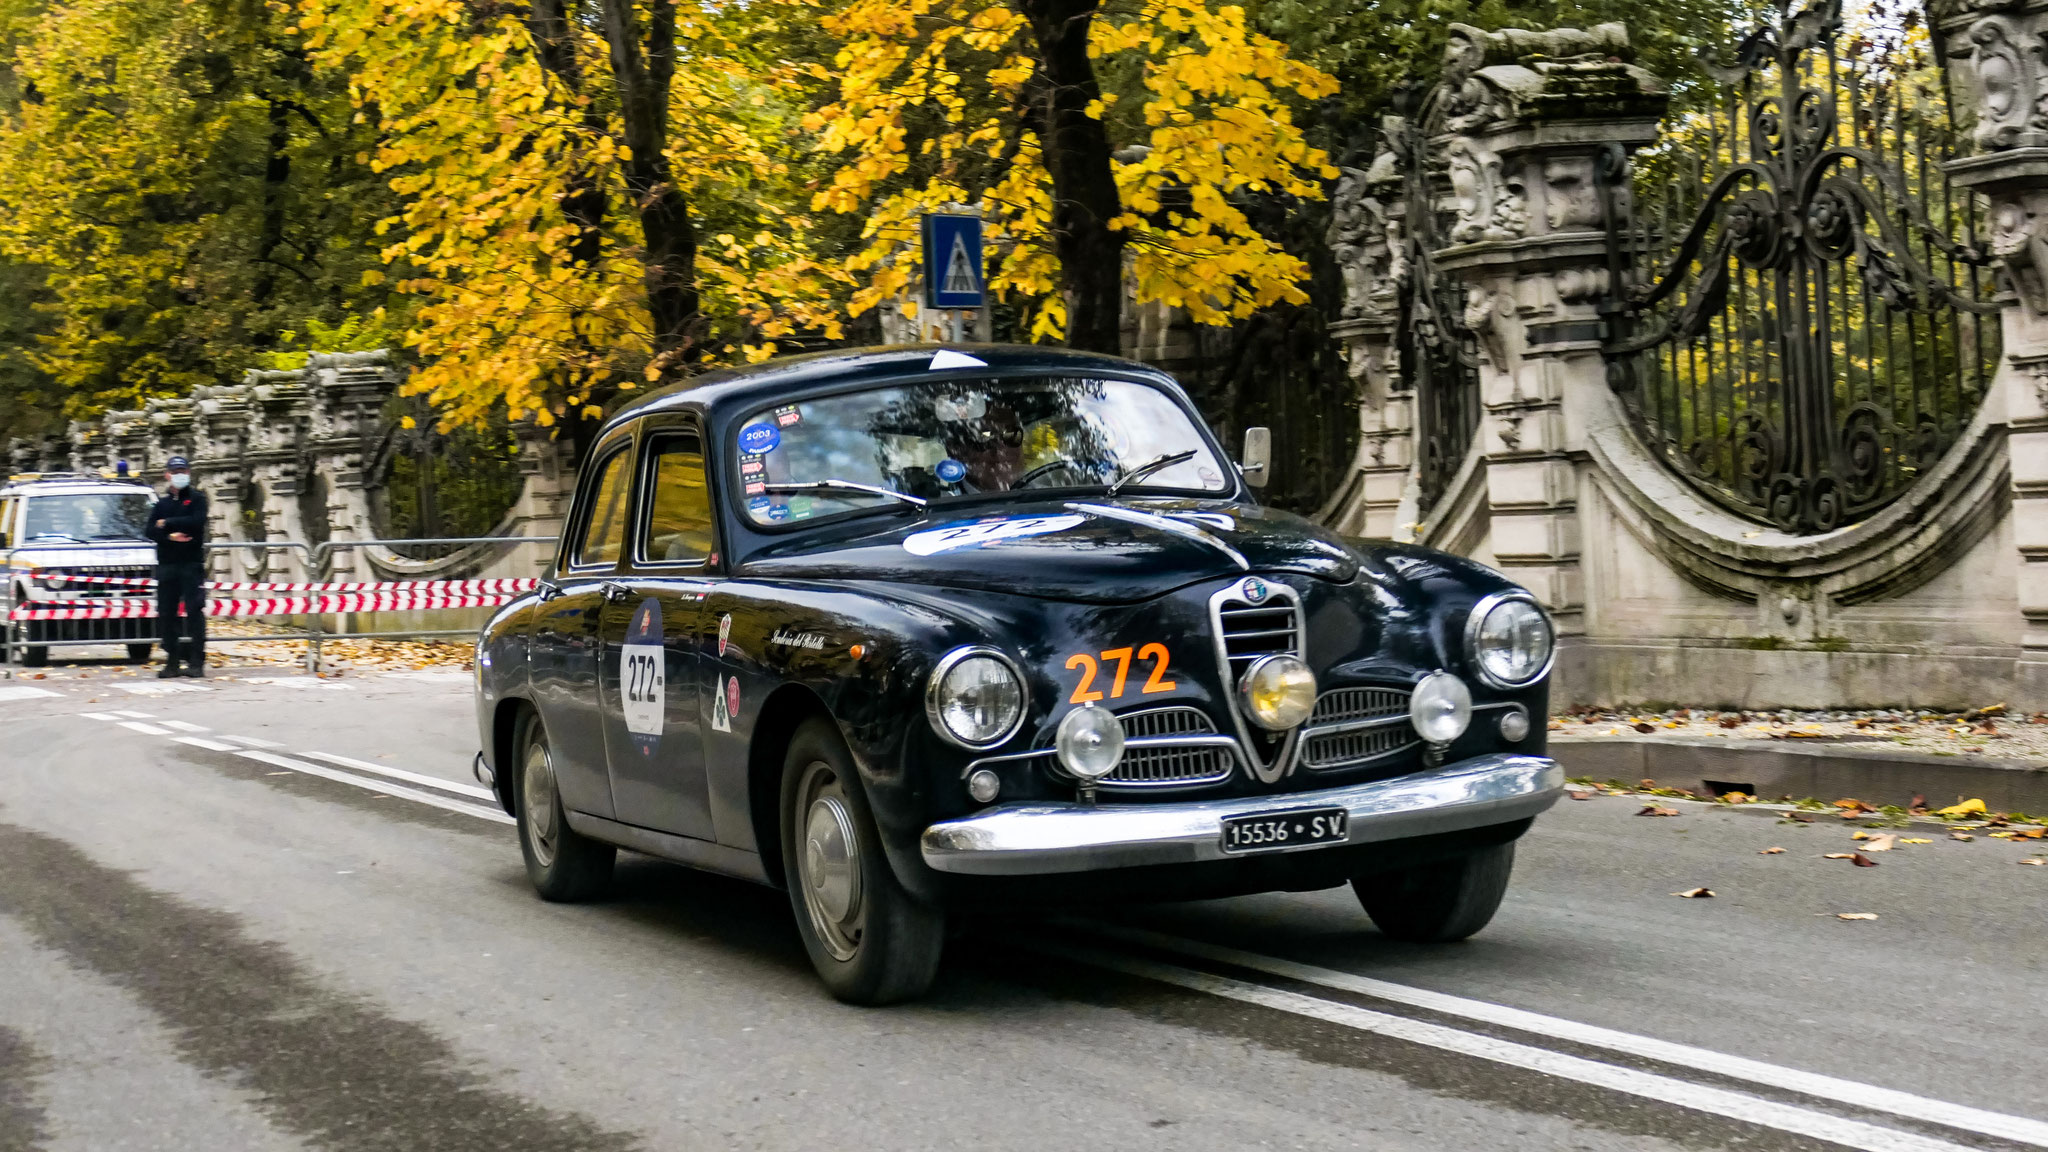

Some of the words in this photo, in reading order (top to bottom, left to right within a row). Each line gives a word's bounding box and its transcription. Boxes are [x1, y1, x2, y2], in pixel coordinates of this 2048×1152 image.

[747, 430, 771, 441] 2003
[940, 520, 1046, 541] 272
[629, 655, 656, 702] 272
[1065, 643, 1176, 704] 272
[1231, 821, 1289, 844] 15536
